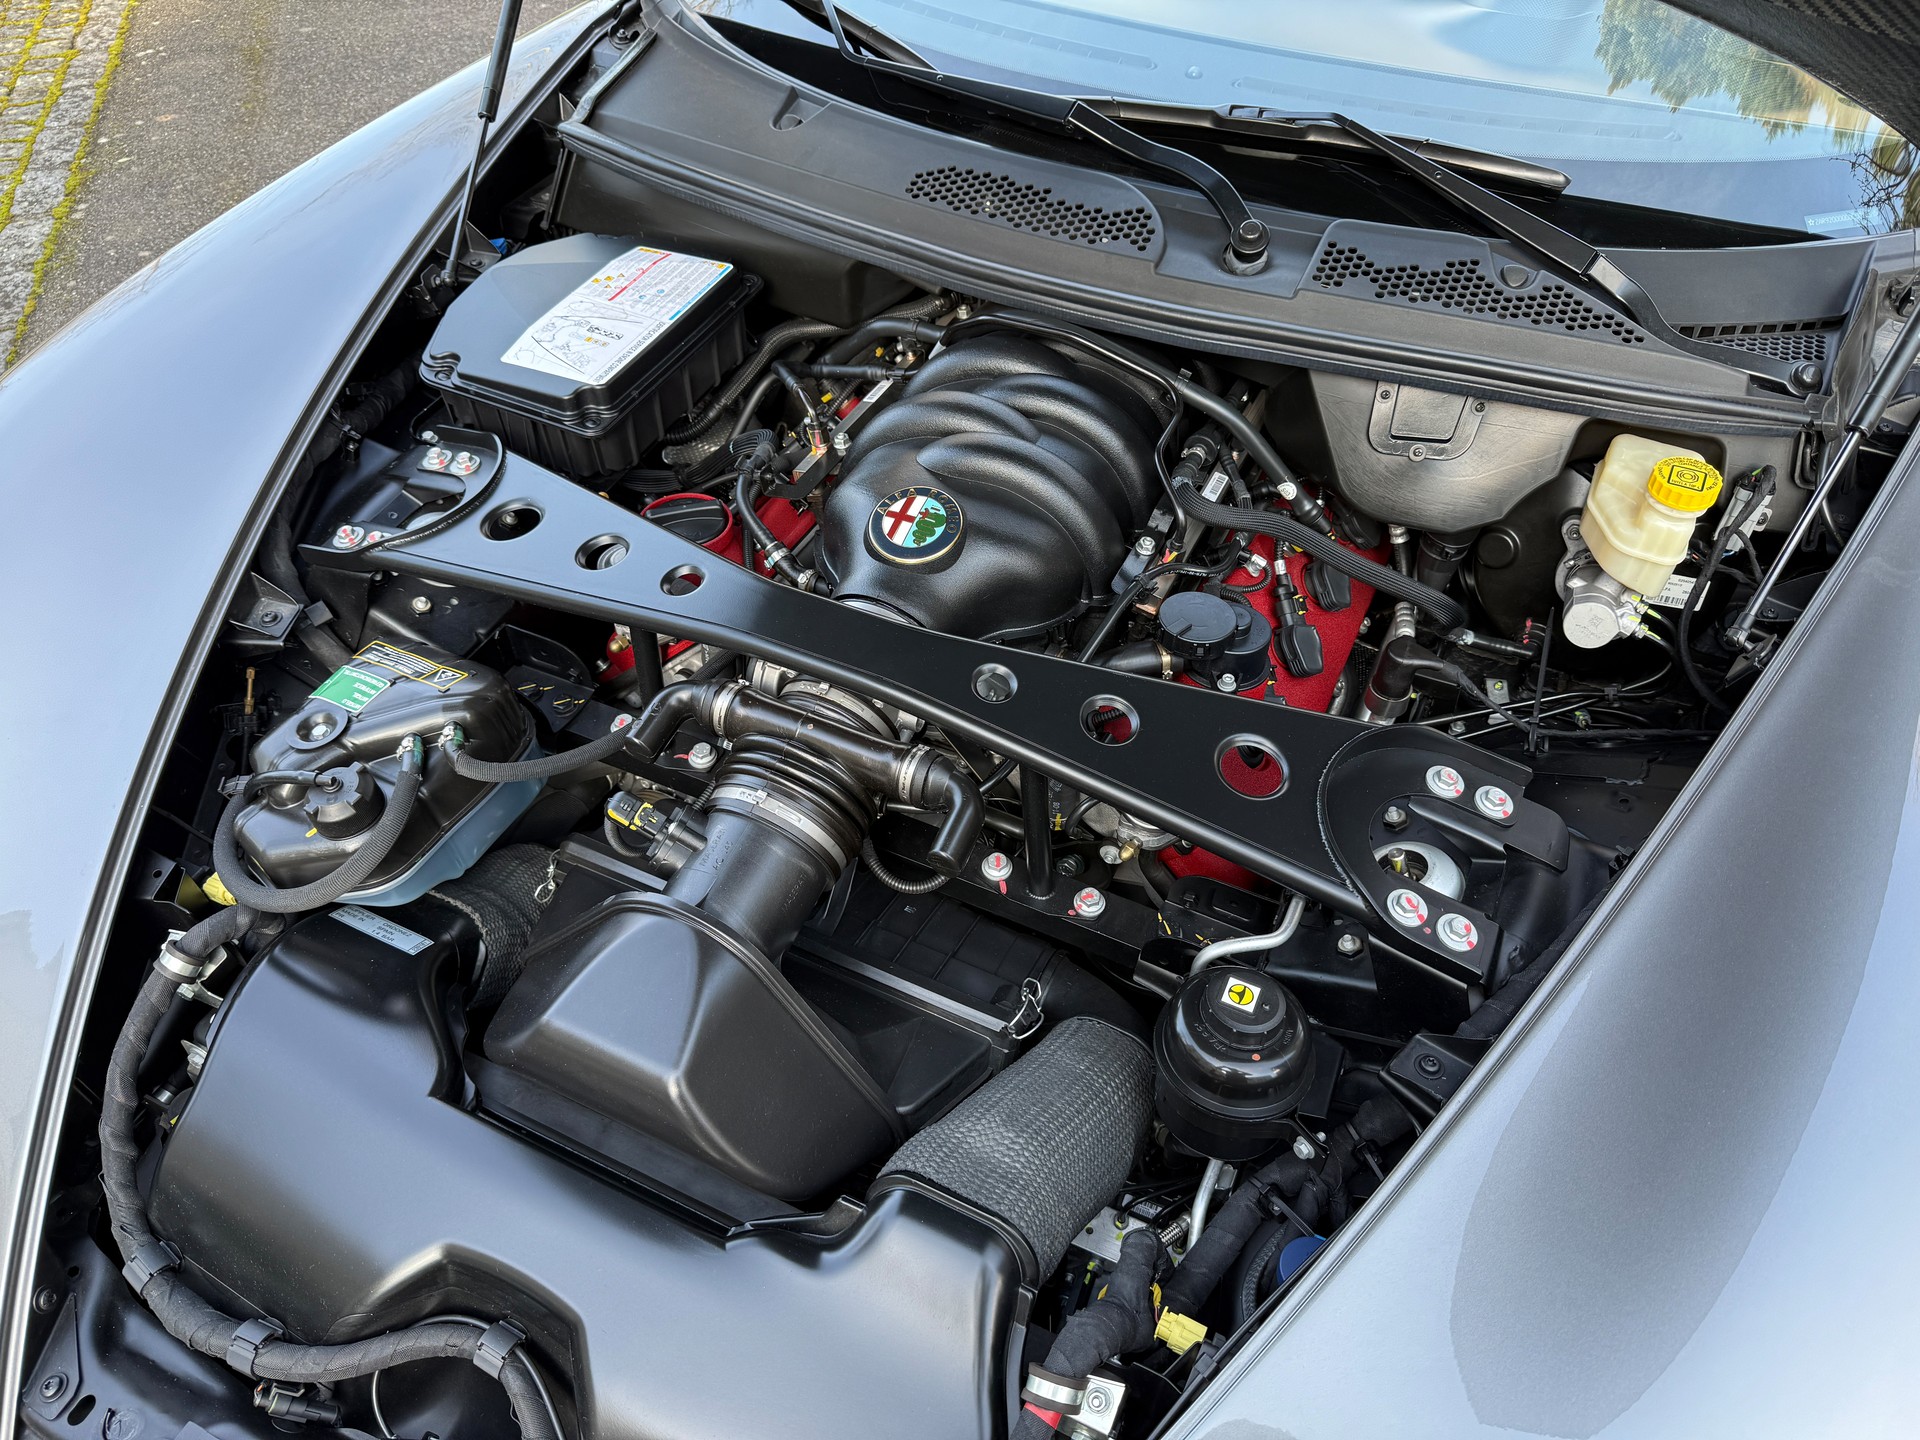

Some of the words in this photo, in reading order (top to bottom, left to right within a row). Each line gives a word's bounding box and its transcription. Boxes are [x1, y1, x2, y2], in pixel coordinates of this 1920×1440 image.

[877, 488, 917, 515] ALFA
[927, 489, 959, 534] ROMEO
[341, 698, 361, 710] ANTIGELO
[341, 908, 358, 918] MADE
[377, 925, 395, 936] SPAIN
[348, 905, 376, 921] SUPPLIER
[382, 922, 413, 937] ORDONEZ
[381, 934, 395, 942] BAR
